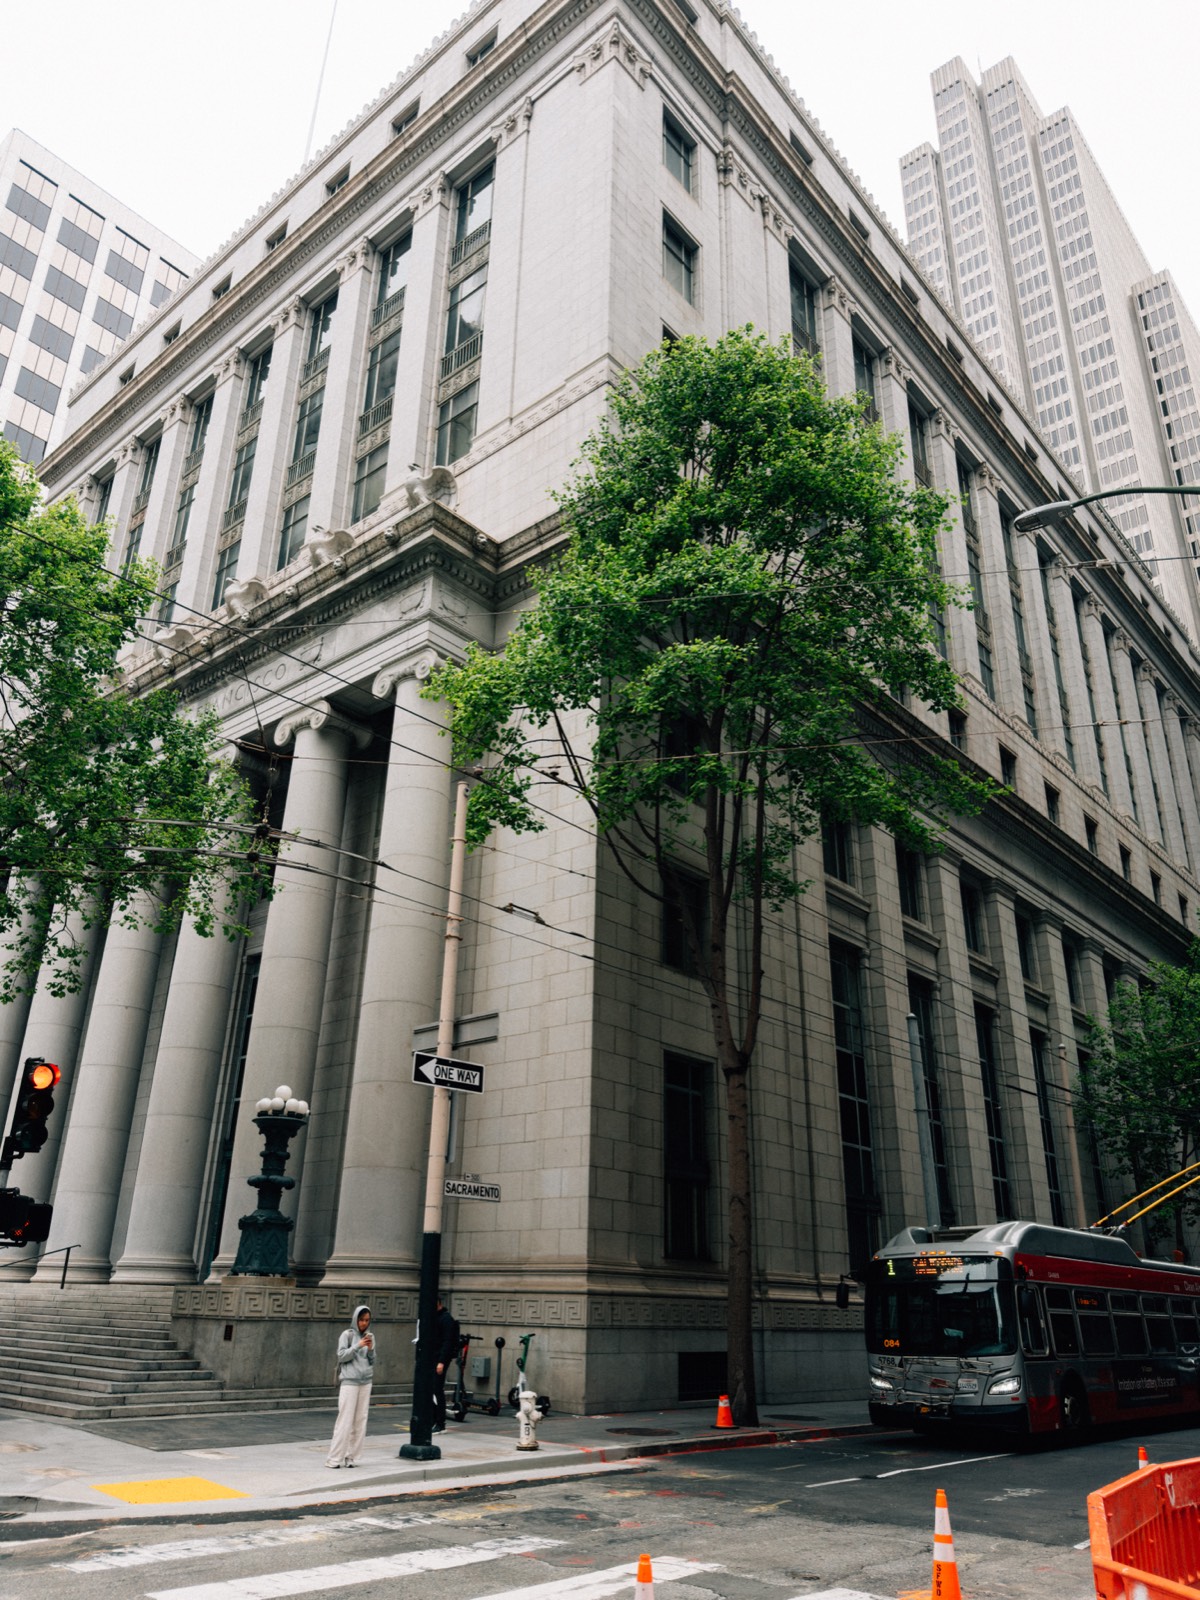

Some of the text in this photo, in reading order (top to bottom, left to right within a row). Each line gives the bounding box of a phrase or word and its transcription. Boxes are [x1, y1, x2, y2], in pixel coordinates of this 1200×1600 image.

[434, 1065, 478, 1084] ONE WAY
[445, 1182, 500, 1198] SACRAMENTO
[887, 1259, 895, 1275] 1
[884, 1339, 900, 1347] 084
[878, 1356, 895, 1365] 5768
